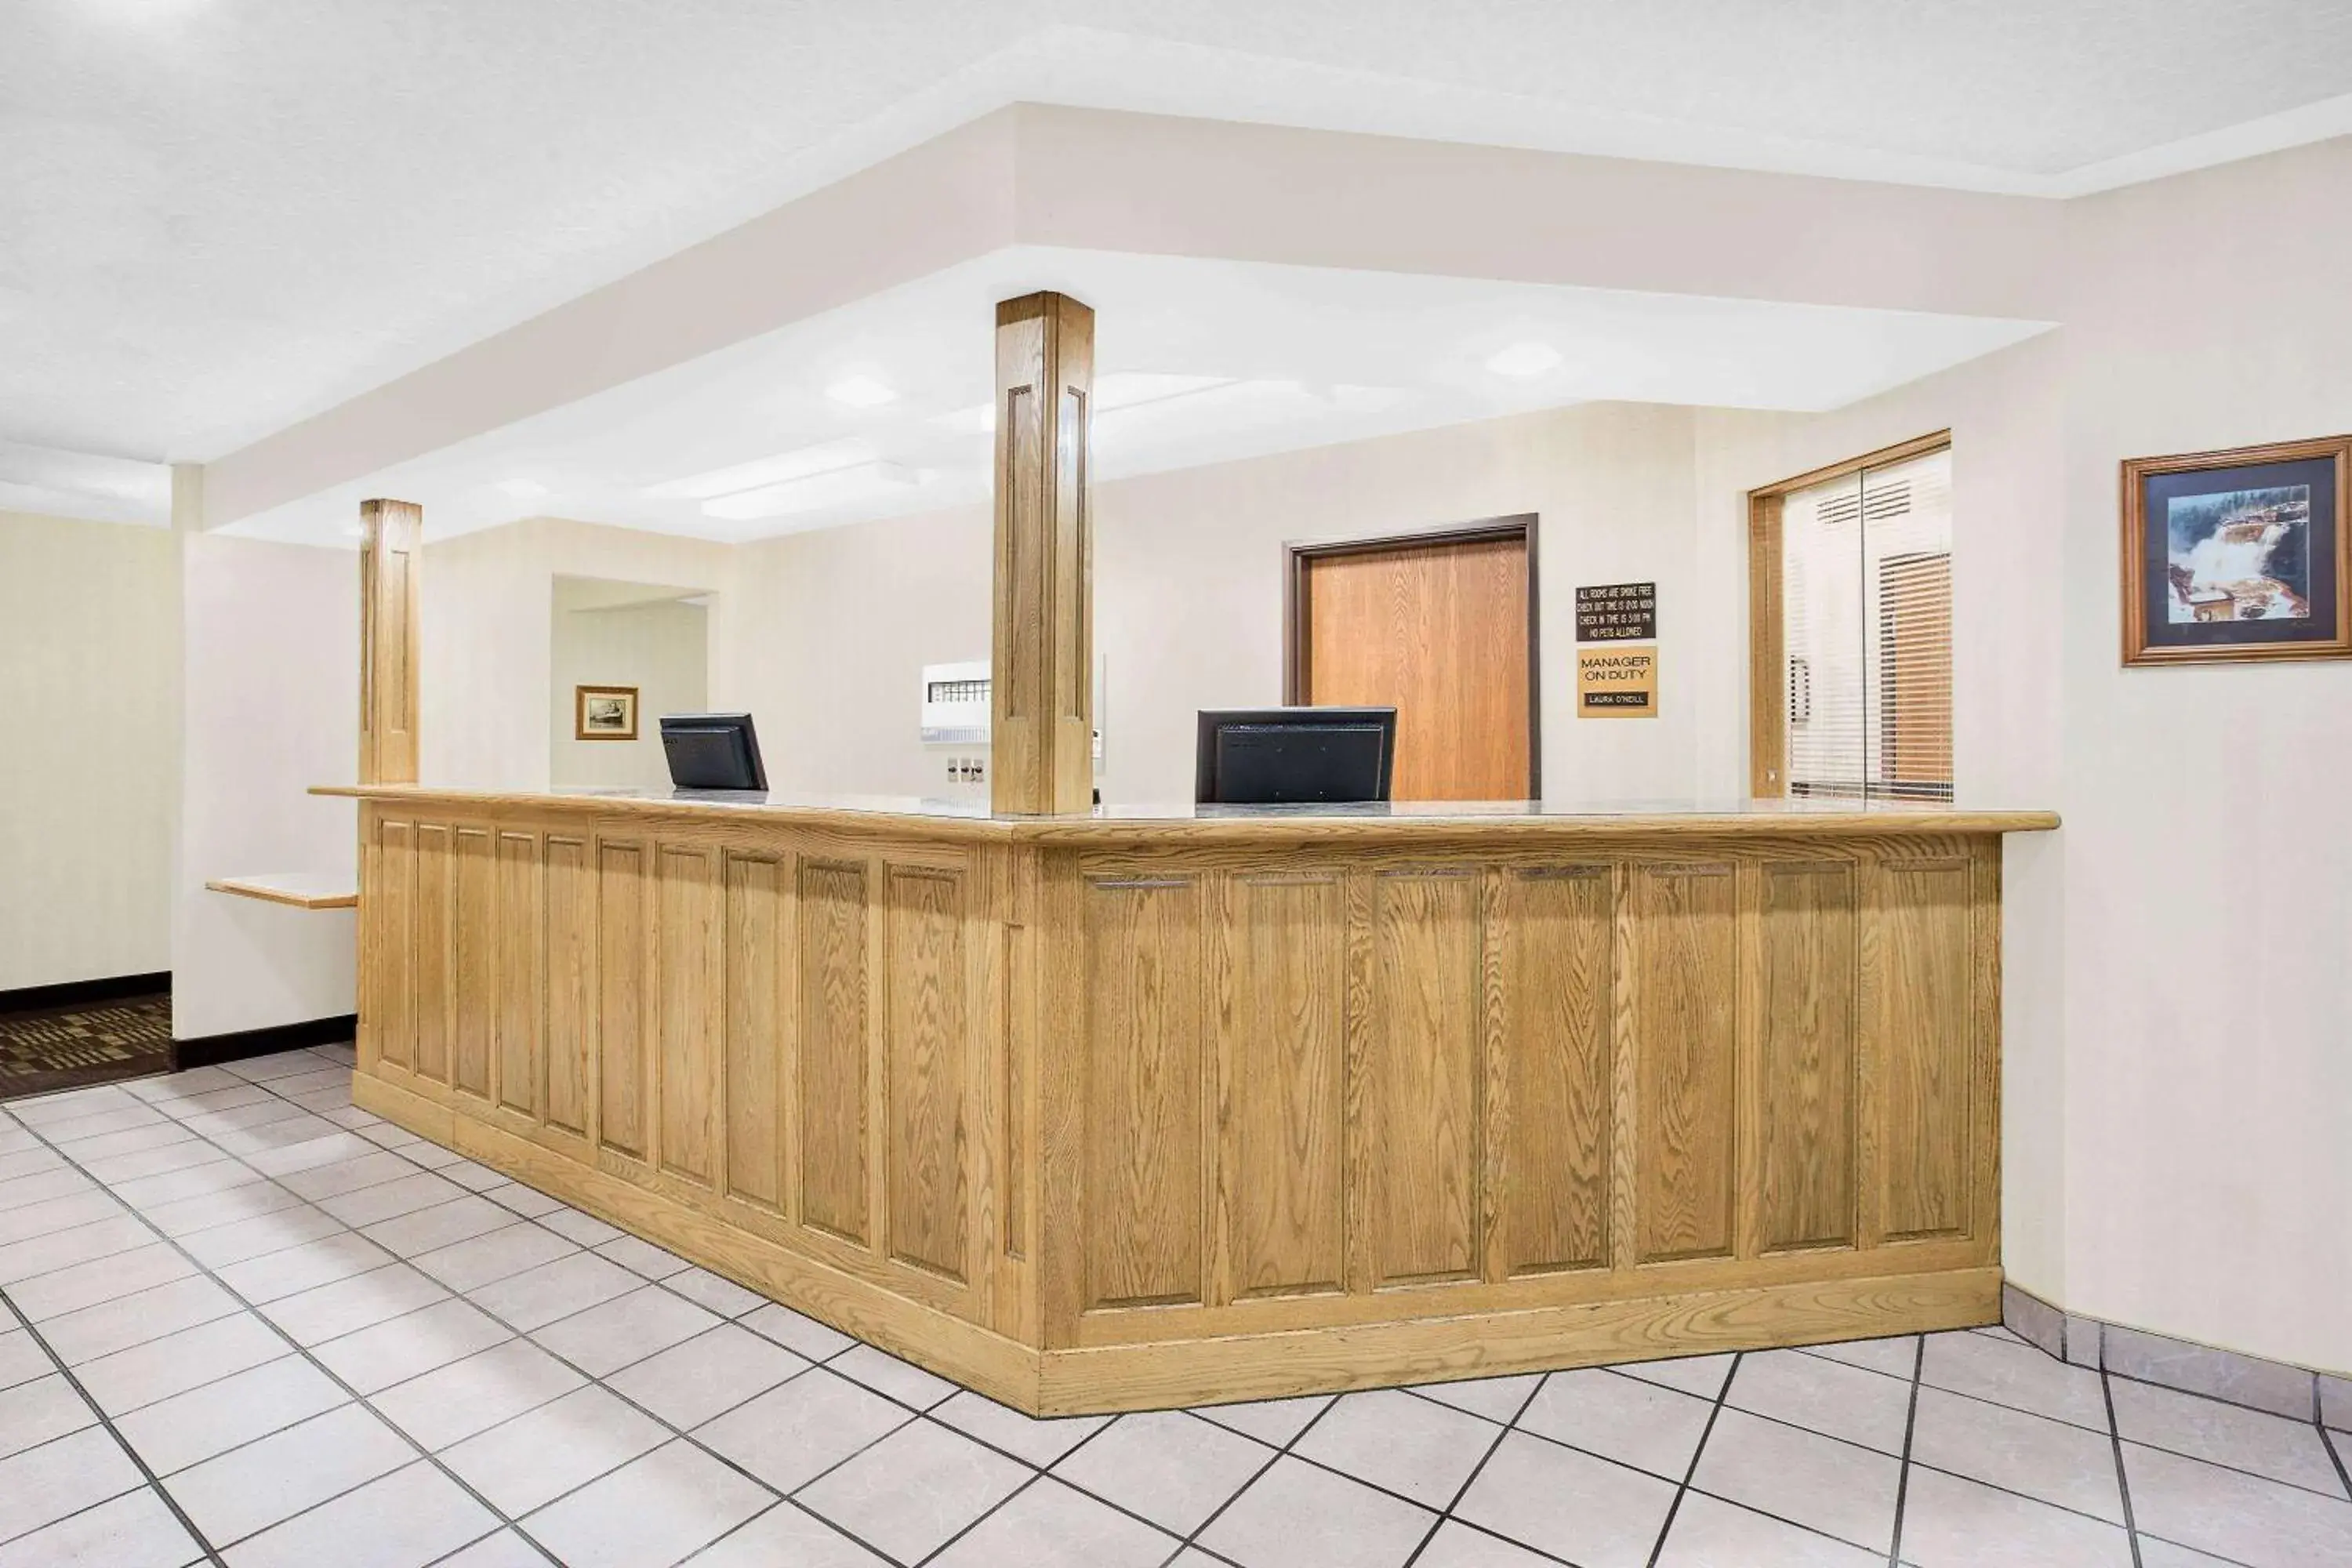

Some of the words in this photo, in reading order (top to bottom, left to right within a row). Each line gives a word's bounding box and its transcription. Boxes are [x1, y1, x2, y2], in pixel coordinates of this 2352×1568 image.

[1639, 586, 1653, 597] FREE
[1580, 615, 1598, 625] CHECK
[1606, 614, 1619, 624] TIME
[1590, 628, 1599, 637] NO
[1616, 626, 1642, 637] ALLOWED
[1581, 656, 1650, 668] MANAGER
[1585, 671, 1606, 681] ON
[1609, 670, 1647, 680] DUTY
